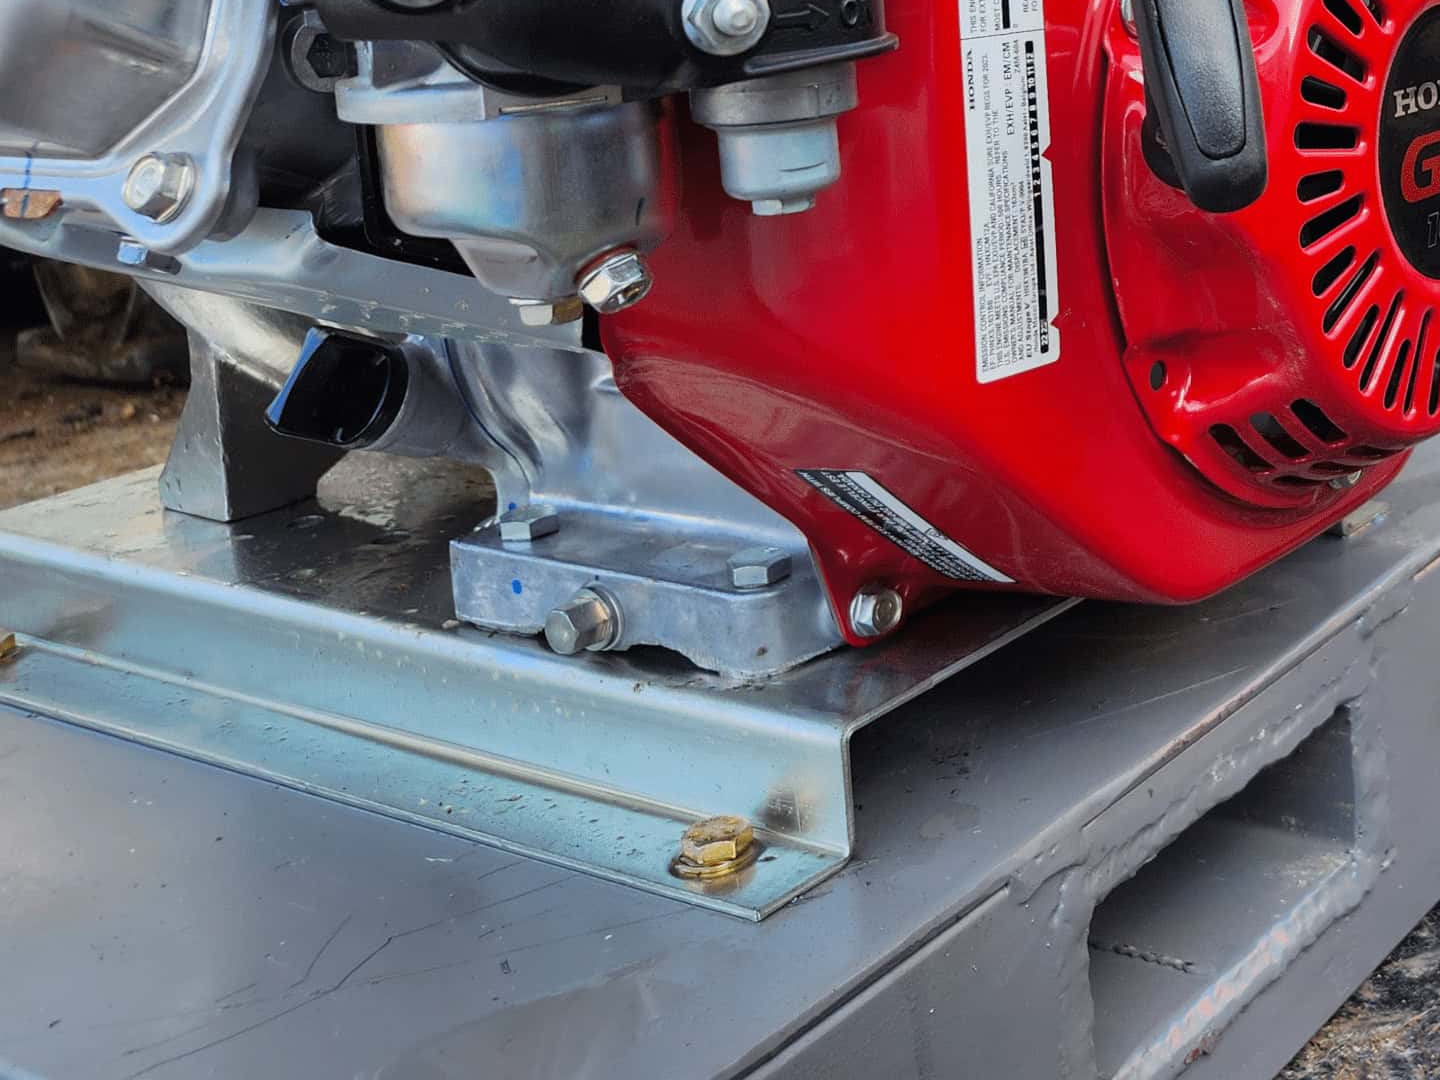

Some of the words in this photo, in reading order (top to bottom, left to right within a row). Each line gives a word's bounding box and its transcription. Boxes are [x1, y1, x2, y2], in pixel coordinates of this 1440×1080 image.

[980, 16, 988, 32] FOR
[967, 48, 975, 112] HONDA
[1002, 41, 1012, 81] EM/CM
[993, 127, 1000, 138] TO
[1004, 87, 1015, 136] EXH/EVP
[988, 167, 996, 212] CALIFORNIA
[1002, 150, 1010, 213] SPECIFICATIONS
[976, 238, 985, 292] INFORMATION
[1005, 215, 1013, 271] MAINTENANCE
[1000, 254, 1008, 303] COMPLIANCE
[995, 321, 1003, 350] ENGINE
[1002, 305, 1010, 349] EMISSIONS
[1026, 342, 1033, 359] EU
